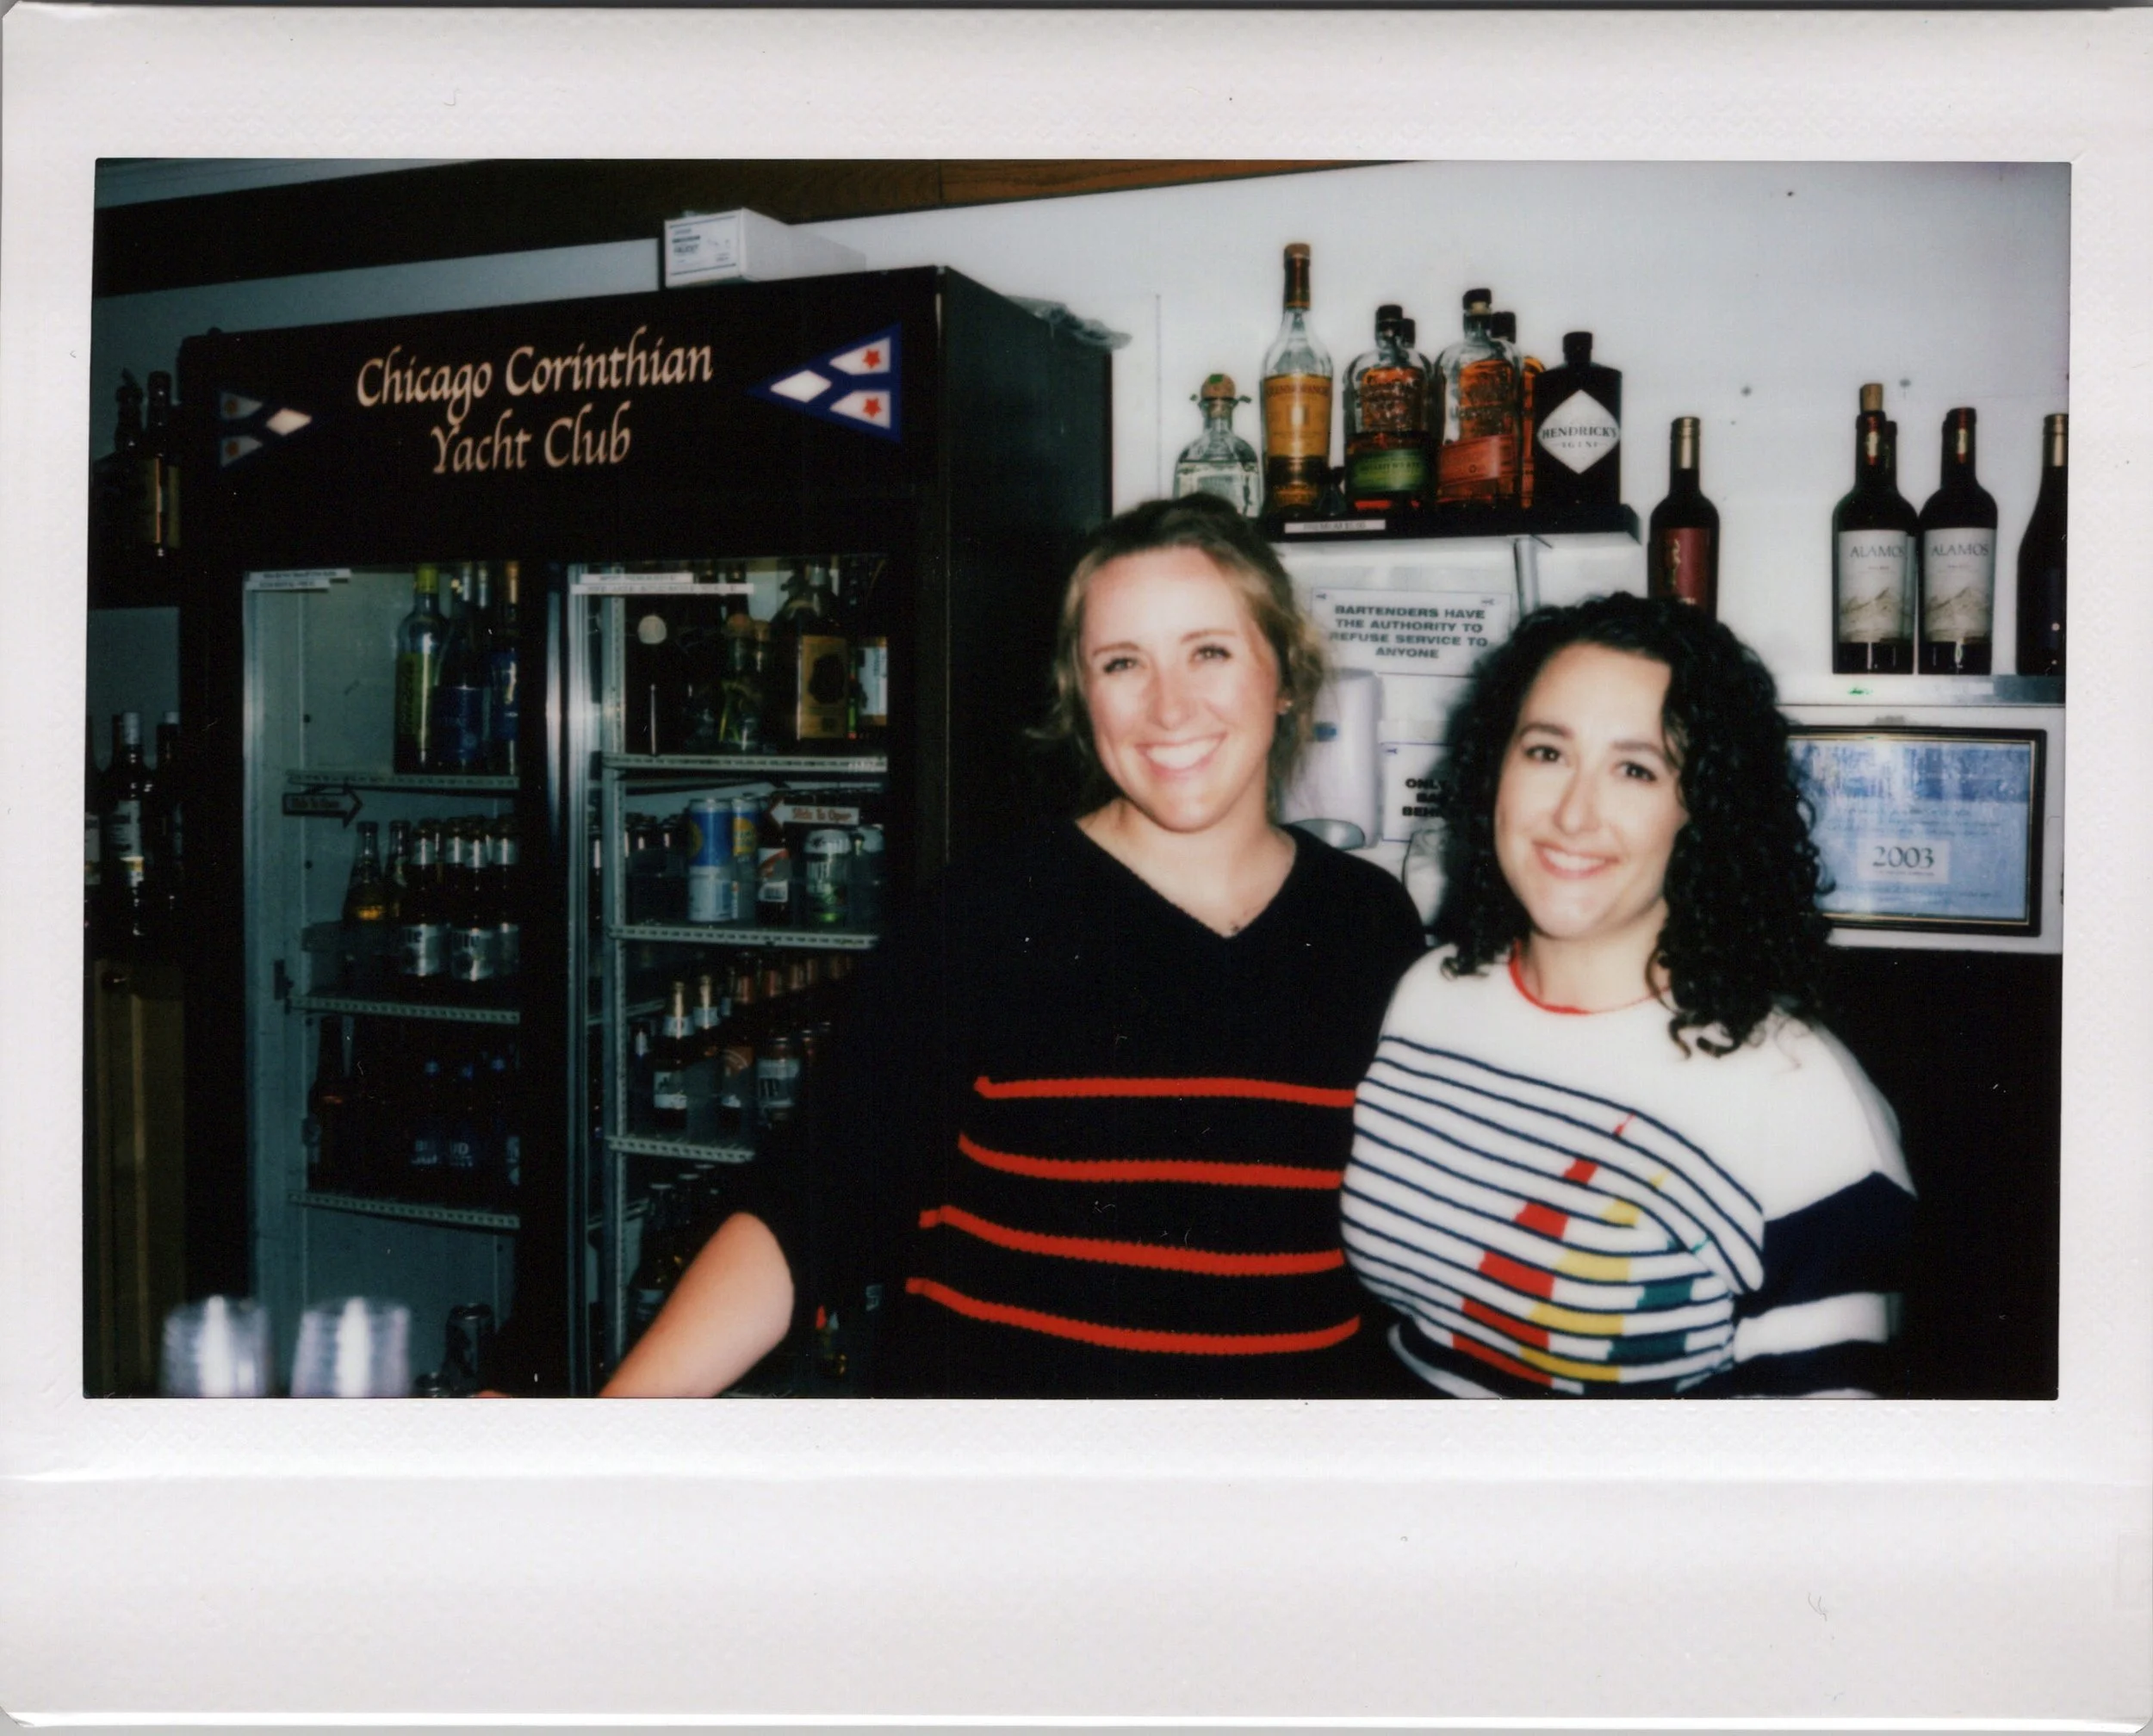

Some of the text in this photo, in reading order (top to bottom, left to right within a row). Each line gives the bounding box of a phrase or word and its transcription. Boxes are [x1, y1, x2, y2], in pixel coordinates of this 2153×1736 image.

[357, 326, 714, 426] Chicago Corinthian
[431, 400, 631, 474] Yacht Club
[1542, 426, 1617, 440] HENDRICK'S
[1851, 544, 1907, 558] ALAMOS
[1932, 542, 1990, 557] ALAMOS
[1335, 604, 1486, 619] BARTENDERS HAVE
[1337, 618, 1484, 634] THE AUTHORITY TO
[1330, 631, 1489, 648] REFUSE SERVICE TO
[1374, 647, 1440, 659] ANYONE
[1871, 846, 1936, 869] 2003
